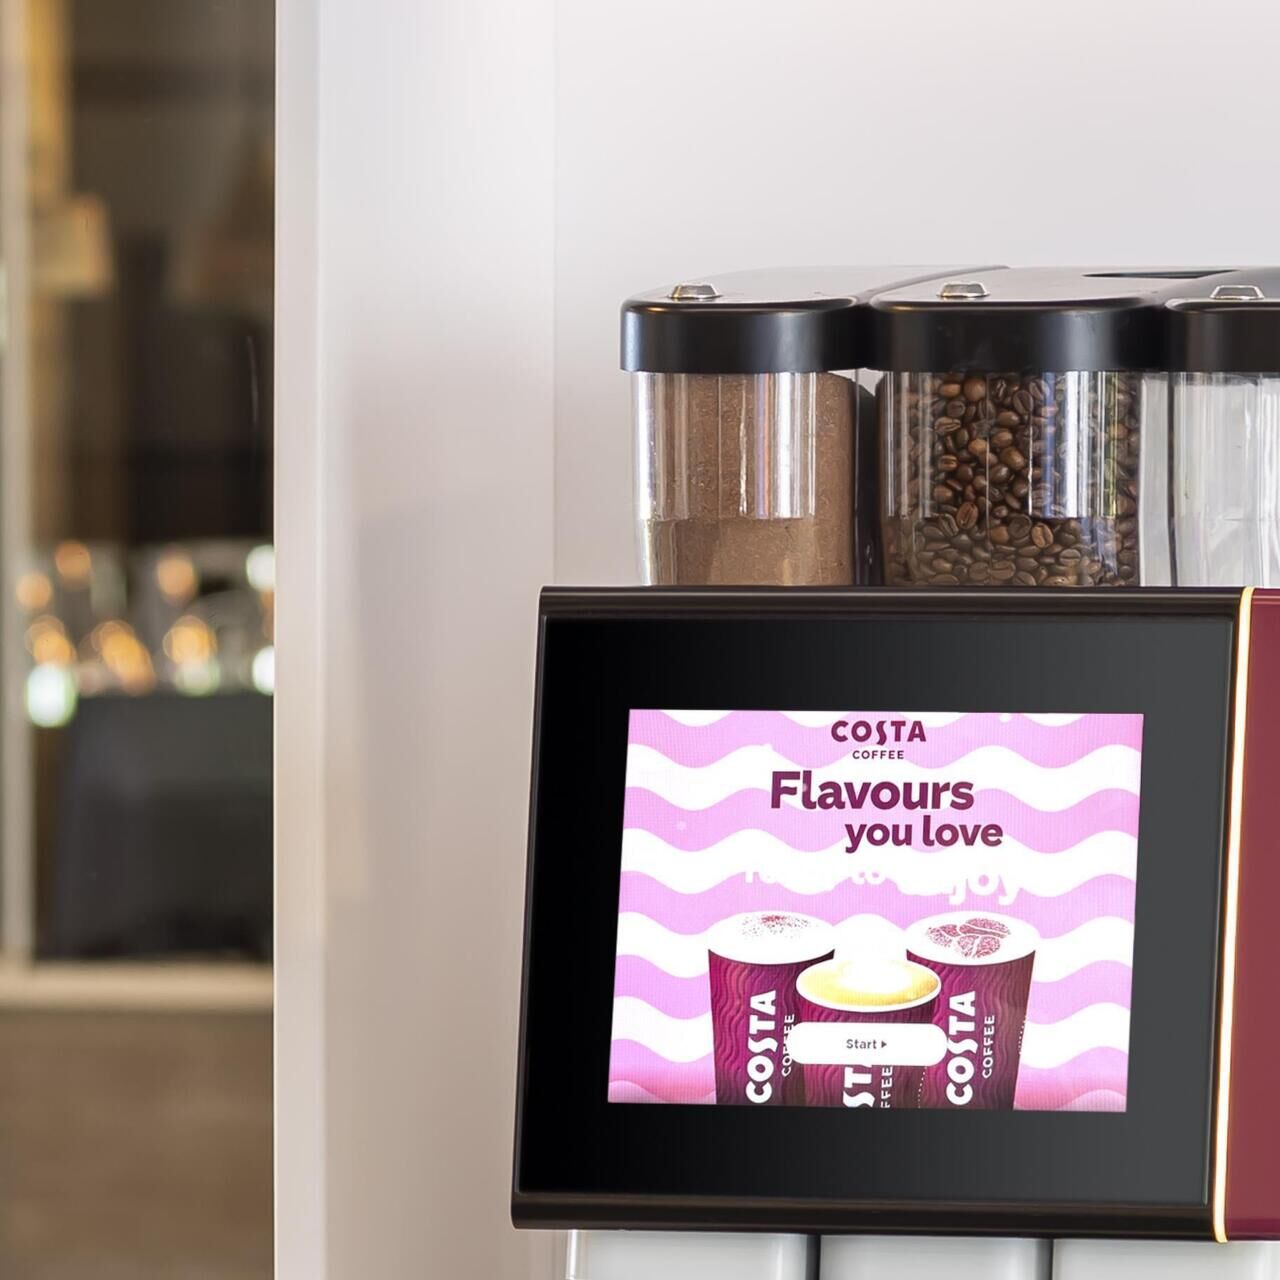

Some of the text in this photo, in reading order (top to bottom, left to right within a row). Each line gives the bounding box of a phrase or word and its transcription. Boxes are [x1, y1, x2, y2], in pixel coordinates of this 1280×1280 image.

[831, 720, 927, 746] COSTA
[852, 750, 905, 760] COFFEE
[770, 770, 975, 811] Flavours
[845, 815, 1004, 854] you love
[745, 990, 778, 1104] COSTA
[846, 1038, 878, 1050] Start
[946, 990, 979, 1106] COSTA
[982, 1015, 995, 1079] COFFEE
